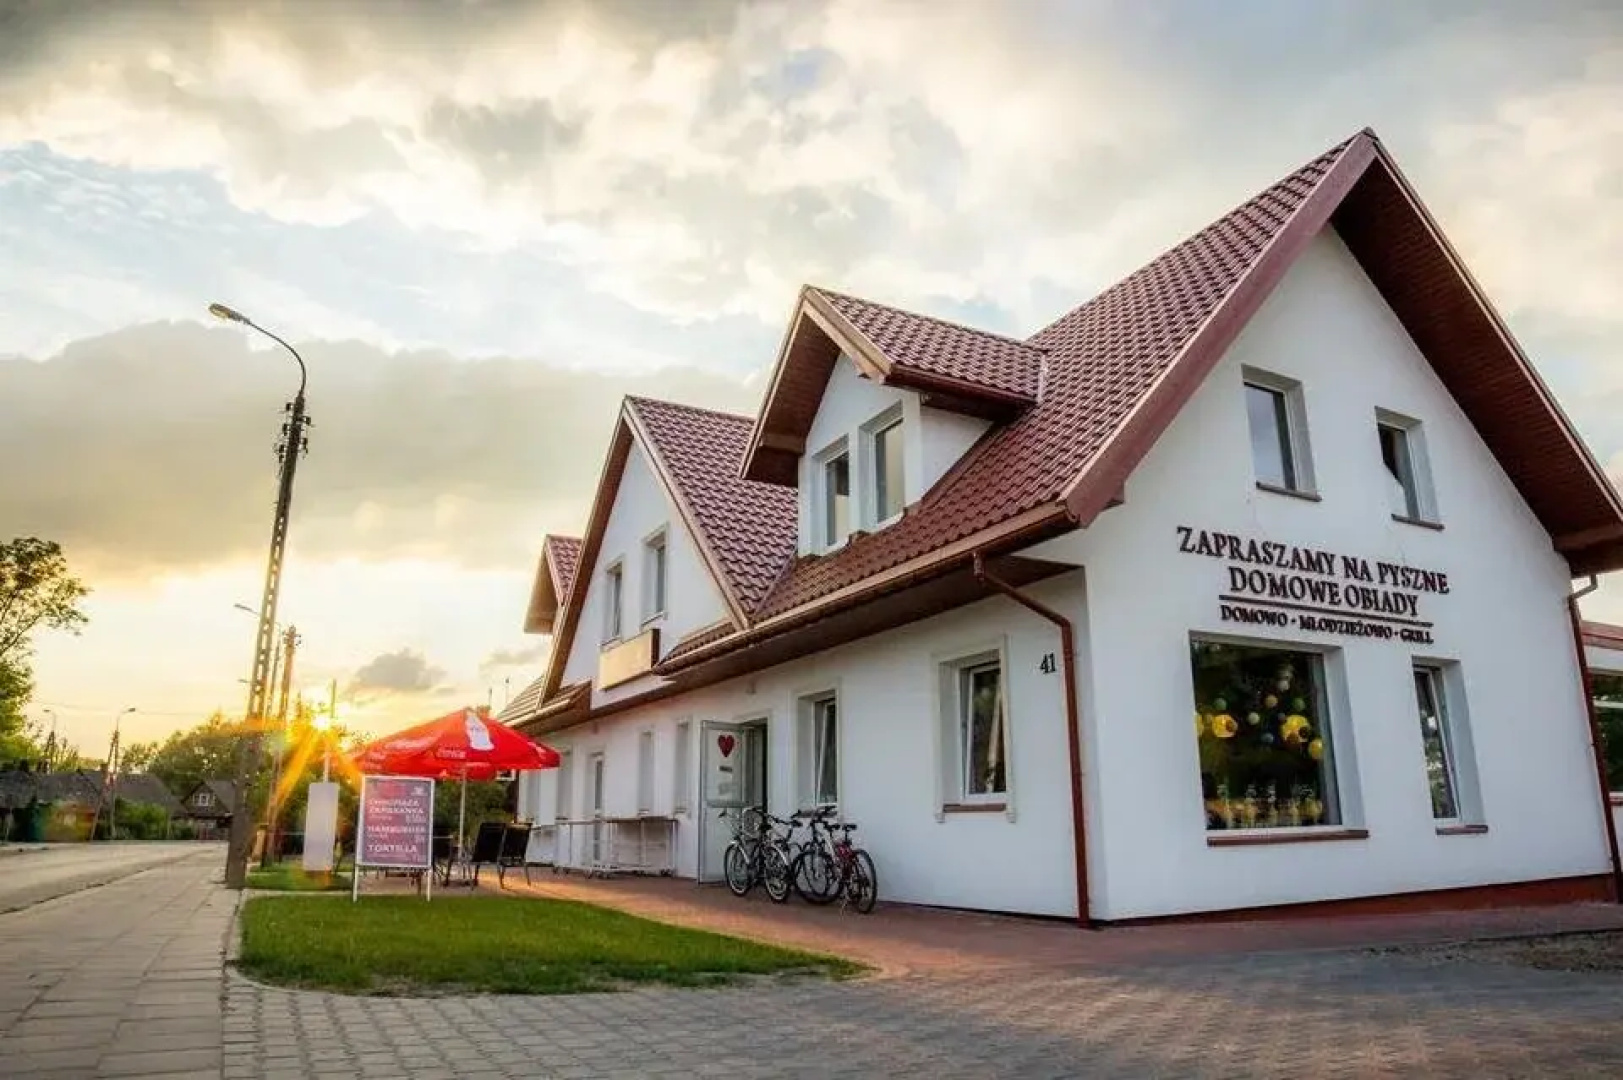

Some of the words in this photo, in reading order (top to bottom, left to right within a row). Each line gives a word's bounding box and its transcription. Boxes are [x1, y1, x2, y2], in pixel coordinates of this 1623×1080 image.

[1176, 526, 1336, 576] ZAPRASZAMY
[1341, 555, 1374, 583] NA
[1376, 561, 1450, 594] PYSZNE
[1228, 566, 1342, 606] DOMOWE
[1344, 584, 1420, 617] OBIADY
[1220, 604, 1288, 627] DOMOWO
[1040, 652, 1056, 674] 41
